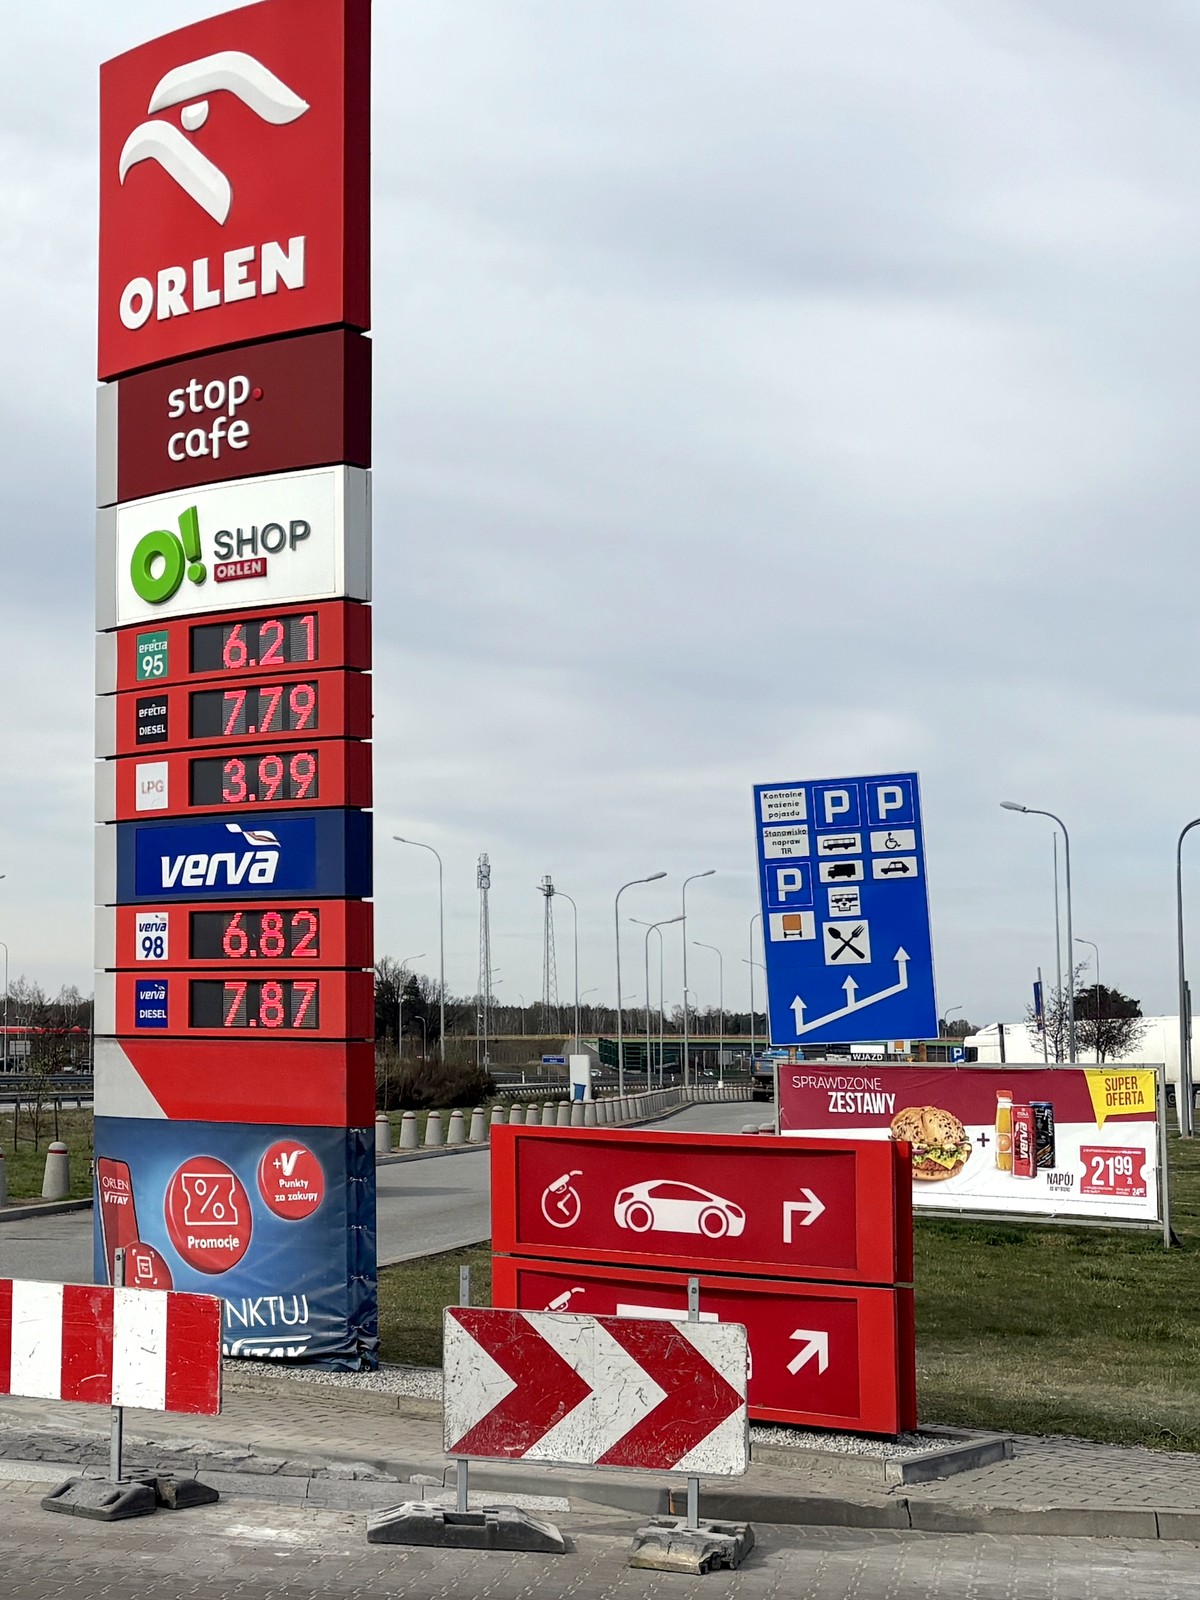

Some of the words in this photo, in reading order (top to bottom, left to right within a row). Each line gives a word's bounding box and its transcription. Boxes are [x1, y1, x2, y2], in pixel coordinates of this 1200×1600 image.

[119, 235, 306, 331] ORLEN
[168, 416, 250, 461] cafe
[214, 520, 311, 560] SHOP
[216, 561, 262, 578] ORLEN
[223, 615, 316, 669] 6.21
[142, 655, 164, 677] 95
[224, 684, 316, 735] 7.79
[139, 724, 167, 736] DIESEL
[222, 752, 317, 803] 3.99
[141, 779, 164, 795] LPG
[763, 791, 802, 800] Kontrolne
[768, 810, 800, 819] pojazdu
[161, 850, 280, 888] verva
[139, 922, 167, 933] verva
[223, 911, 318, 958] 6.82
[141, 936, 164, 958] 98
[140, 989, 166, 1000] verva
[224, 981, 317, 1028] 7.87
[139, 1009, 167, 1019] DIESEL
[852, 1053, 883, 1061] WJAZD
[792, 1075, 882, 1091] SPRAWDZONE
[1105, 1076, 1138, 1092] SUPER
[828, 1091, 896, 1115] ZESTAWY
[1106, 1091, 1144, 1107] OFERTA
[102, 1176, 129, 1190] ORLEN
[279, 1178, 309, 1190] Punkty
[1046, 1171, 1074, 1186] NAPÓJ
[275, 1193, 286, 1202] za
[288, 1191, 318, 1202] zakupy
[187, 1235, 240, 1251] Promocje
[226, 1295, 309, 1328] NKTUJ
